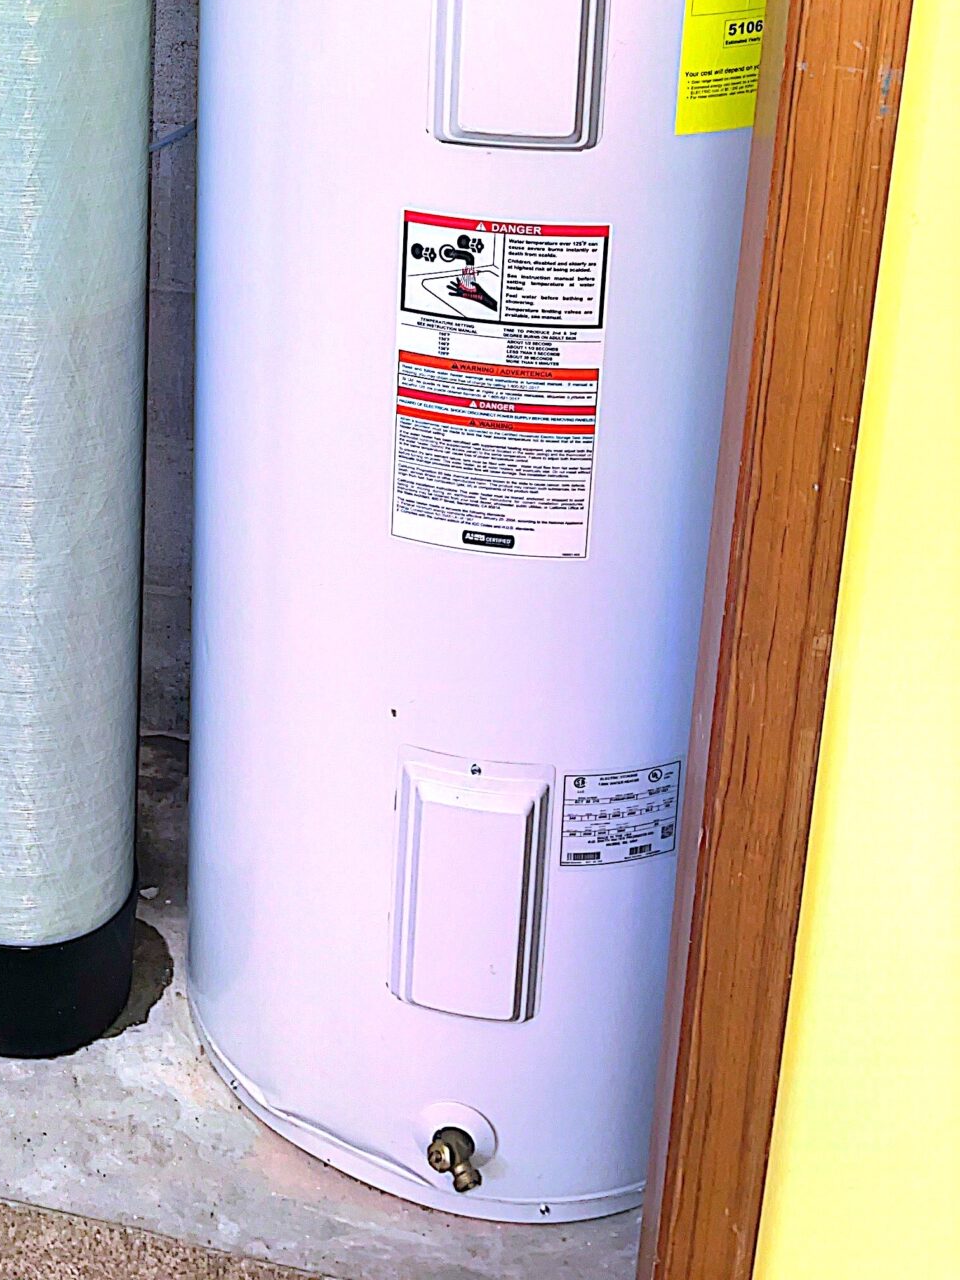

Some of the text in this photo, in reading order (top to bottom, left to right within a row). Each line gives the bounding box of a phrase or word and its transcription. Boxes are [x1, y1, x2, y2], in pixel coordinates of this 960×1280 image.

[725, 66, 744, 74] depend
[492, 224, 542, 235] DANGER
[460, 364, 494, 373] WARNING
[500, 369, 552, 377] ADVERTENCIA
[479, 402, 515, 411] DANGER
[478, 421, 514, 429] WARNING
